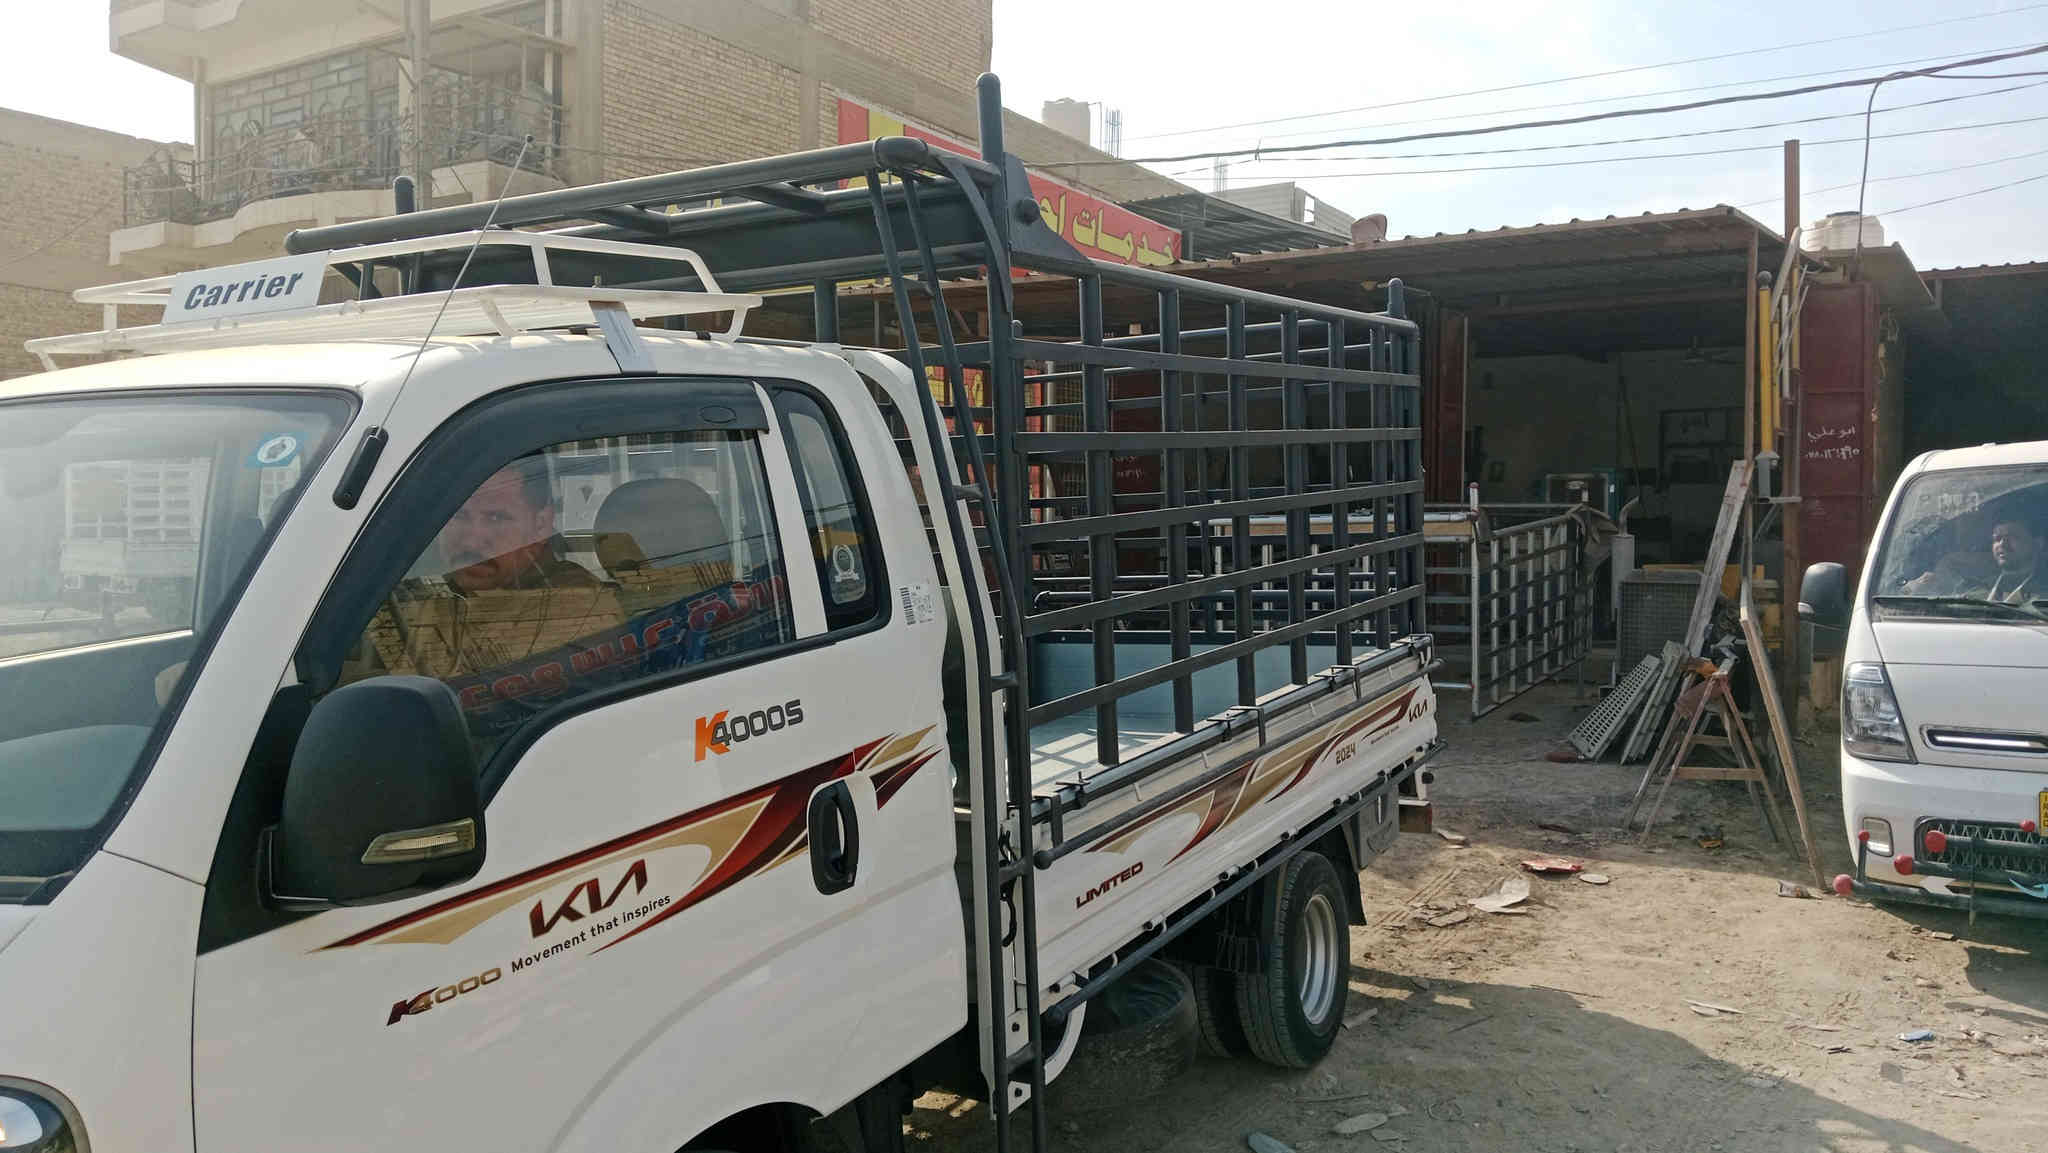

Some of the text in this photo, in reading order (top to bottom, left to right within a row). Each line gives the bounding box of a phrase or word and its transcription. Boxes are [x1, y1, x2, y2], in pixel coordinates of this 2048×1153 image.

[1072, 207, 1175, 266] خدمات
[184, 271, 304, 310] Carrier
[695, 699, 804, 762] K4000S
[1409, 699, 1428, 722] KIA
[1336, 743, 1356, 764] 2024
[529, 858, 648, 938] KIA
[1076, 861, 1144, 909] LIMITED
[511, 894, 671, 973] Movement that inspires
[386, 967, 502, 1026] K4000
